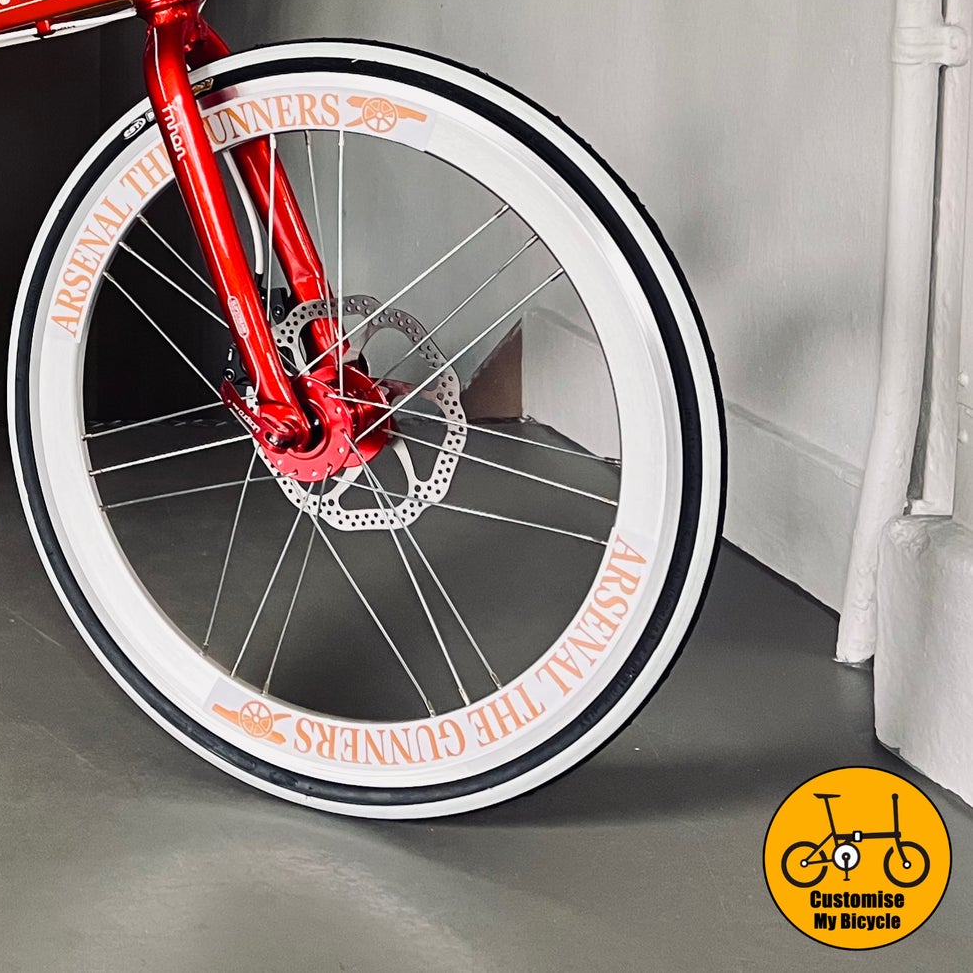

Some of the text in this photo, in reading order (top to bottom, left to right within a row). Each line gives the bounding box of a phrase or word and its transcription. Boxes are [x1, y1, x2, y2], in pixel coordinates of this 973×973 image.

[51, 195, 132, 339] ARSENAL
[201, 92, 340, 146] UNNERS
[294, 534, 648, 766] ARSENAL THE GUNNERS
